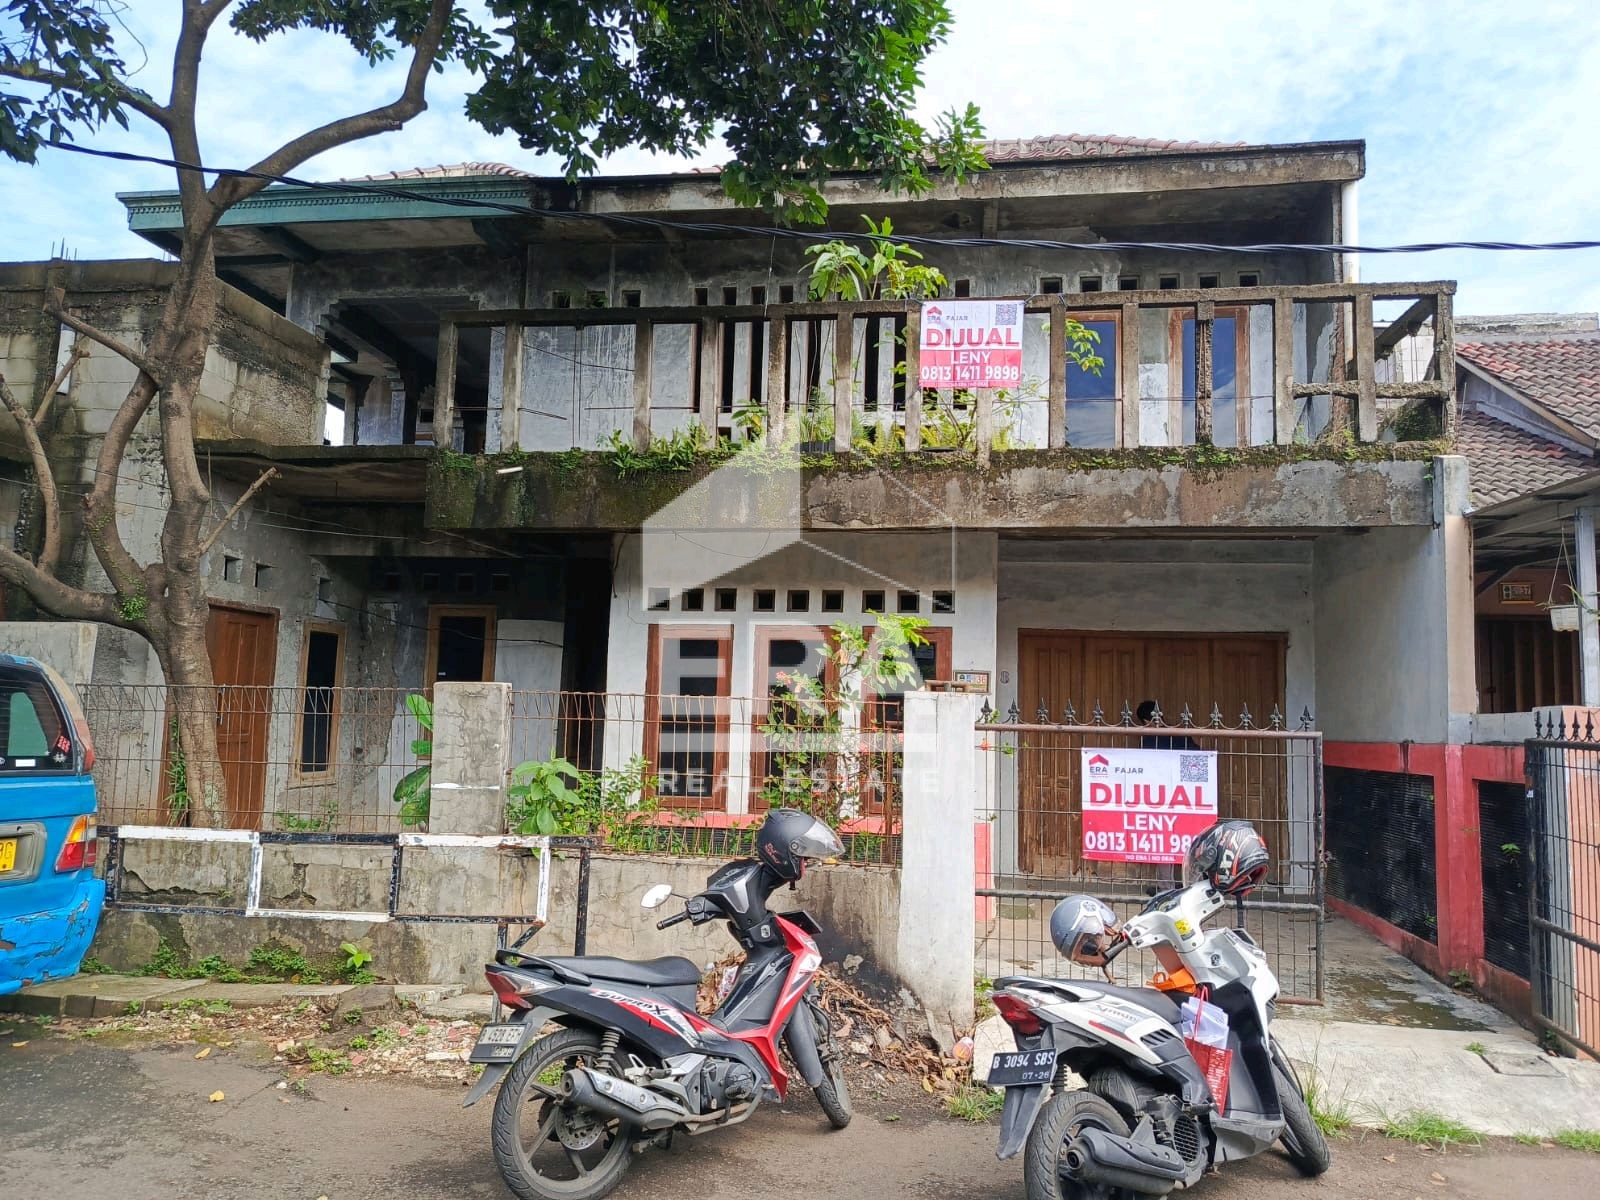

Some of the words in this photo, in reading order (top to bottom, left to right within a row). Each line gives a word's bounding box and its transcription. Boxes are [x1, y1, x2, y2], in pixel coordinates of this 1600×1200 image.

[926, 327, 1020, 347] DIJUAL
[950, 351, 991, 364] LENY
[921, 366, 952, 380] 0813
[956, 366, 980, 380] 1411
[985, 366, 1019, 380] 9898
[1089, 766, 1108, 774] ERA
[1114, 767, 1144, 775] FAJAR
[1089, 782, 1214, 811] DIJUAL
[1123, 813, 1178, 832] LENY
[1085, 831, 1126, 851] 0813
[1130, 832, 1165, 853] 1411
[1169, 834, 1201, 853] 98
[992, 1055, 1000, 1069] B
[1004, 1053, 1030, 1068] 3094
[1034, 1051, 1054, 1066] SBS
